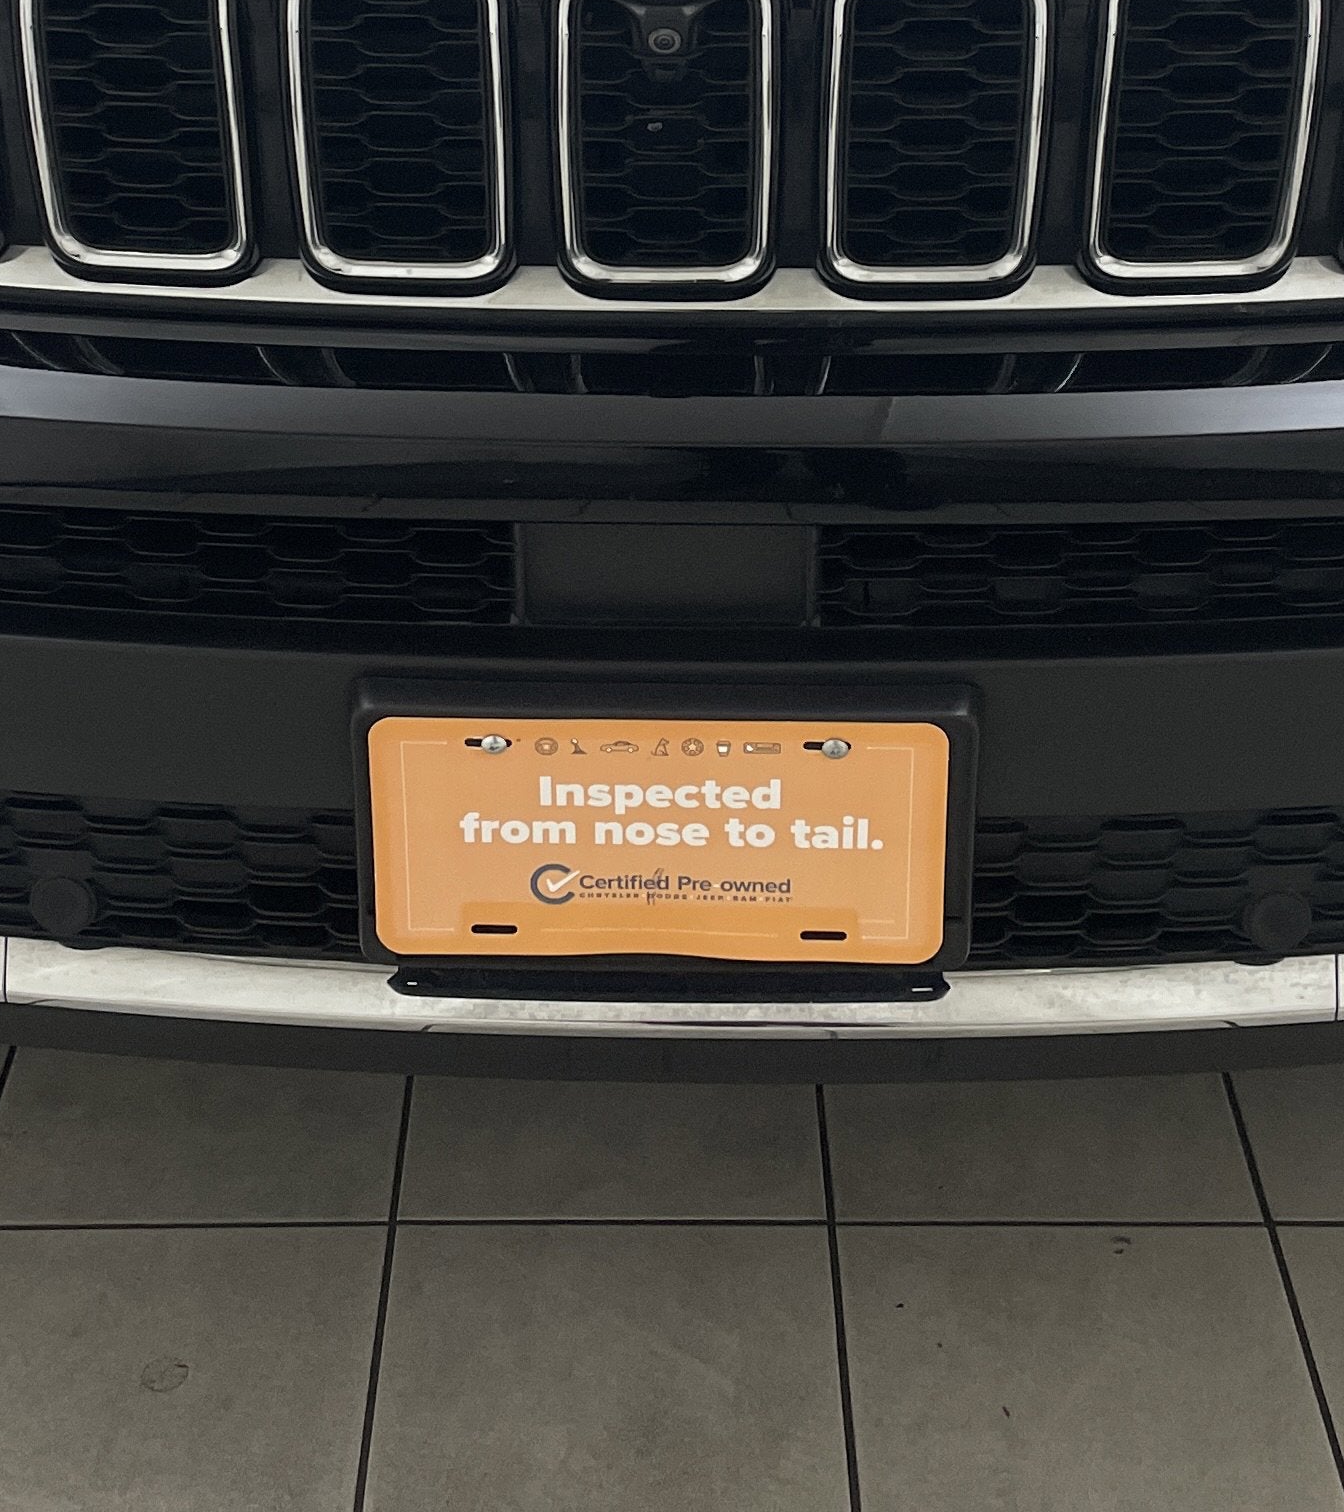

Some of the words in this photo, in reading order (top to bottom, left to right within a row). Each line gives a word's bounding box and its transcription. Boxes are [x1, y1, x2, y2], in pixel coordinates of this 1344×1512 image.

[538, 775, 782, 816] Inspected
[458, 811, 577, 845] from
[594, 821, 710, 848] nose
[723, 817, 776, 849] to
[790, 816, 885, 851] tail.
[578, 874, 670, 891] Certified
[578, 891, 640, 899] CHRYSLER
[696, 894, 725, 902] JEEP
